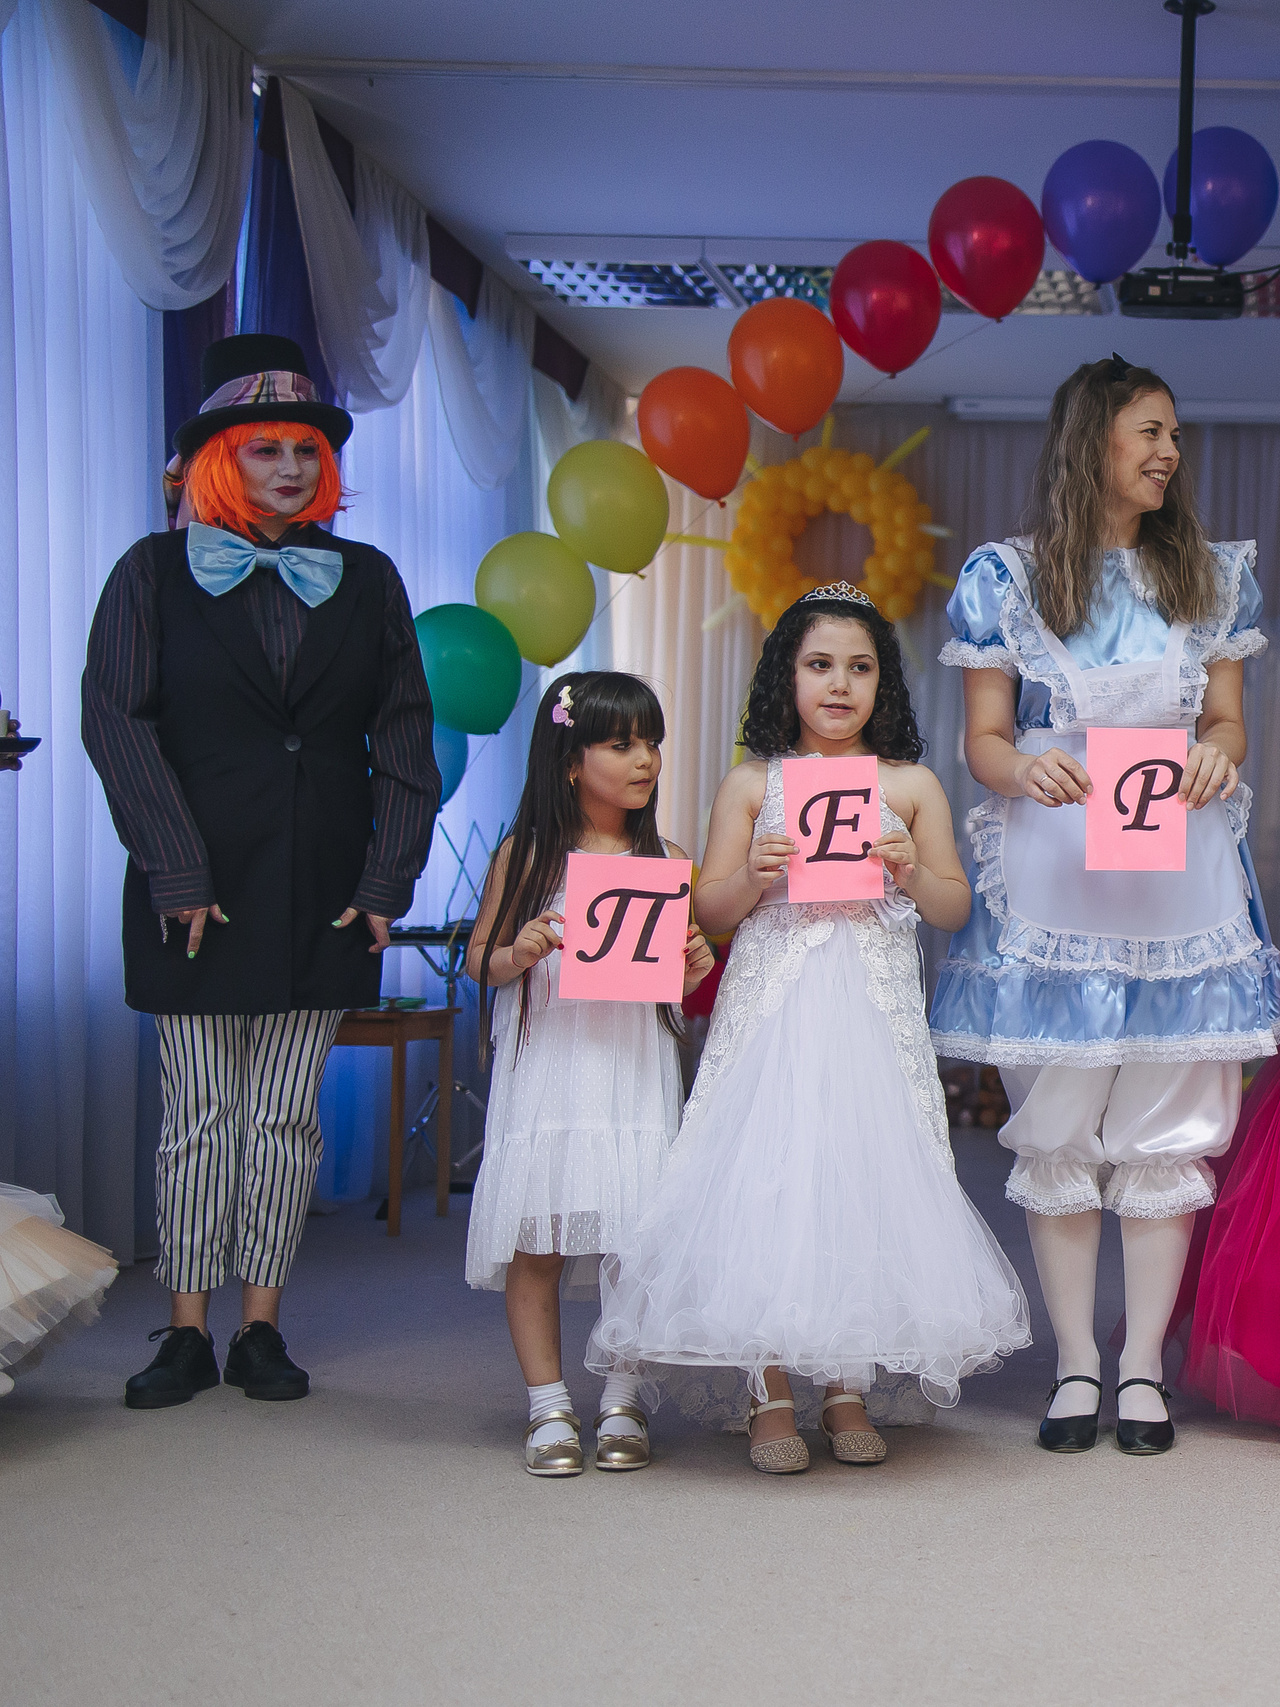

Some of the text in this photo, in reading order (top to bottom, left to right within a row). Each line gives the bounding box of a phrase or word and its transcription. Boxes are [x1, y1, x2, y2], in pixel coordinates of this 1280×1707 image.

[799, 787, 872, 863] Е
[1114, 758, 1184, 831] Р
[577, 882, 690, 963] П
